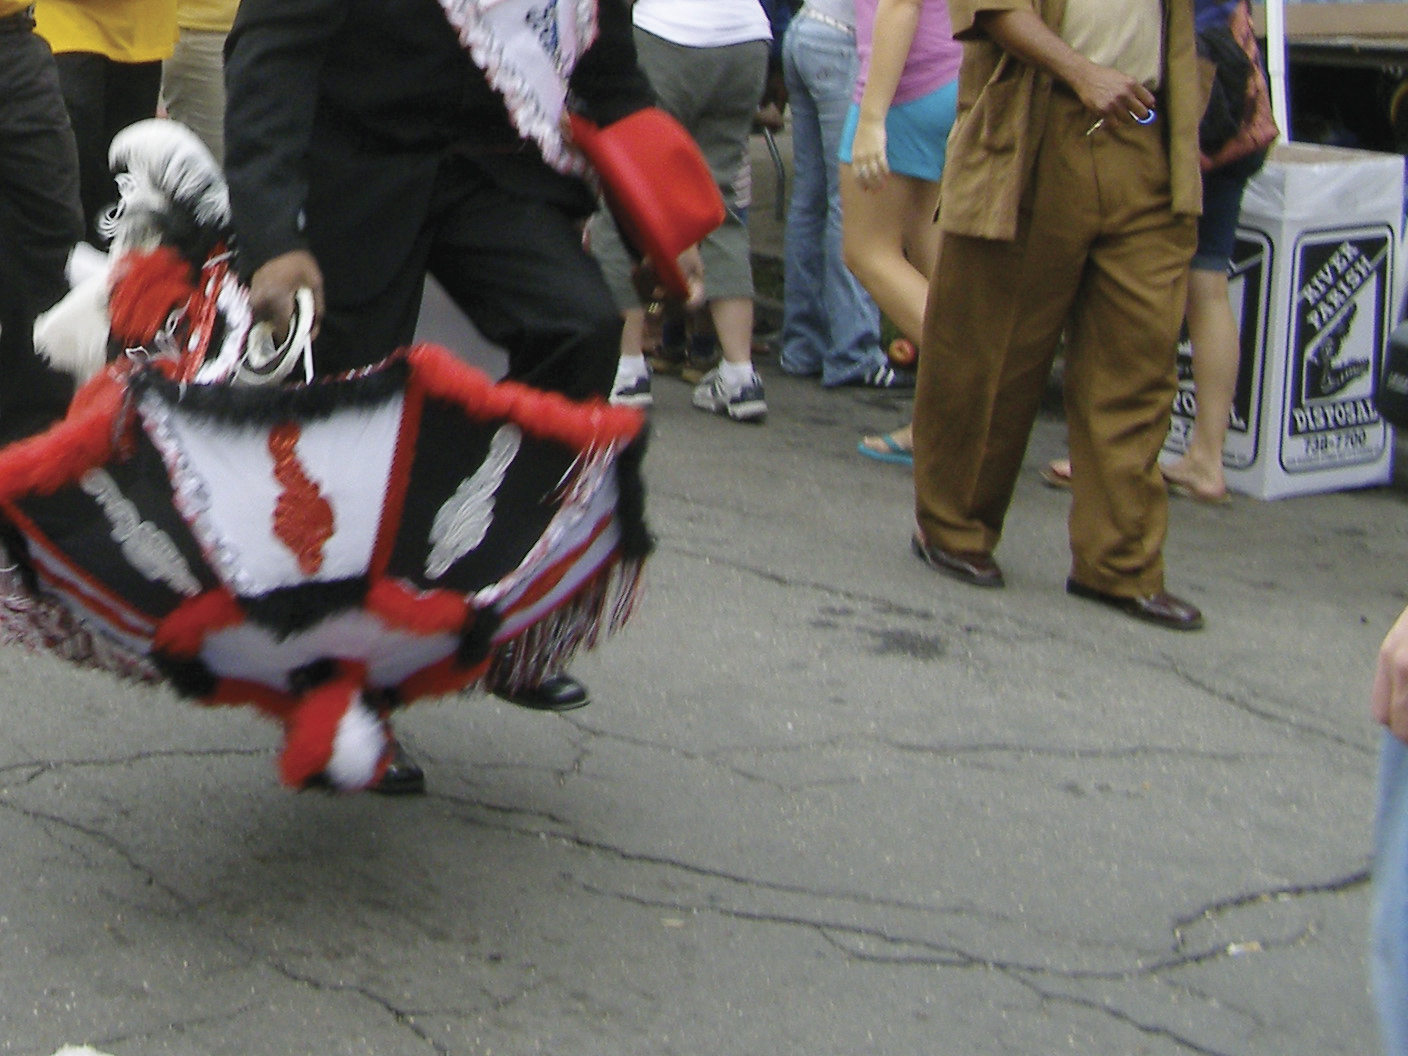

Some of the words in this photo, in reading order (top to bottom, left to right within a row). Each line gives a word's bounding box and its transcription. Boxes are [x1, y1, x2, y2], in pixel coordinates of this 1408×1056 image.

[1301, 240, 1360, 307] RIVER
[1305, 254, 1374, 331] PARISH
[1293, 397, 1379, 433] DISPOSAL
